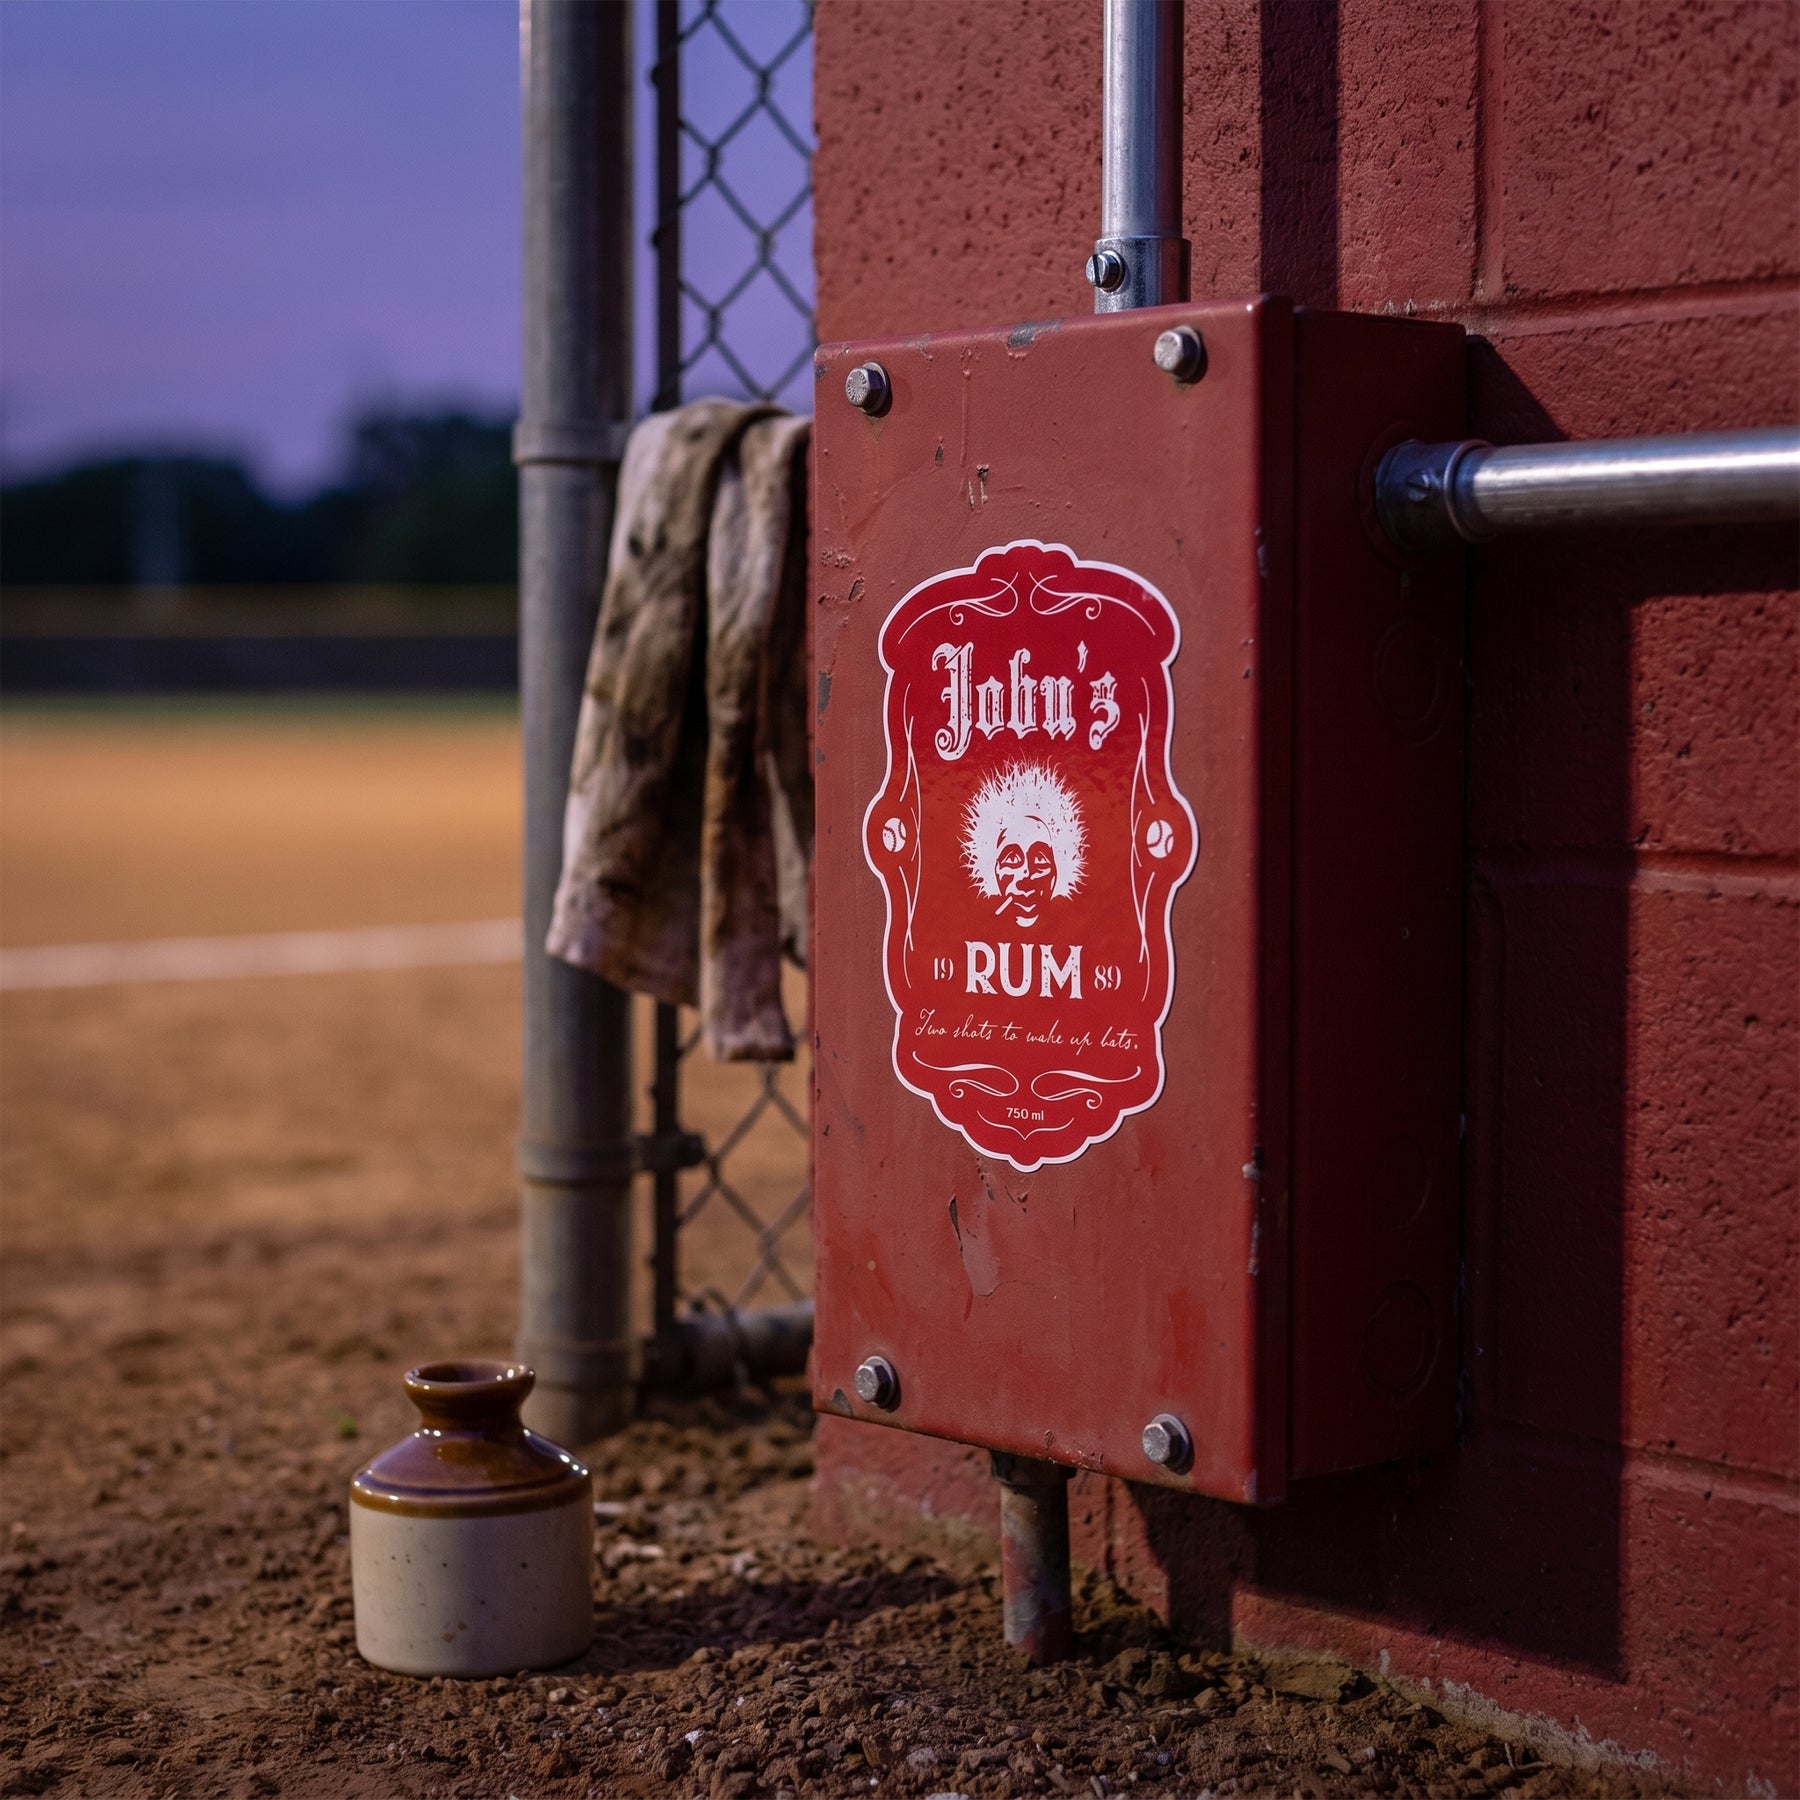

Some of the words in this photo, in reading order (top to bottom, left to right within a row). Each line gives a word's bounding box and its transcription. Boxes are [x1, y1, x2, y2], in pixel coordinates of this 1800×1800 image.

[931, 640, 1121, 761] Jobu's
[933, 957, 954, 981] 19
[964, 940, 1084, 1000] RUM
[1093, 964, 1122, 991] 89
[914, 1007, 948, 1036] Two
[952, 1013, 999, 1041] shots
[1001, 1021, 1023, 1041] to
[1025, 1019, 1064, 1045] wake
[1069, 1031, 1093, 1056] up
[1100, 1025, 1139, 1050] bats.
[1006, 1107, 1029, 1120] 750
[1031, 1109, 1044, 1121] ml
